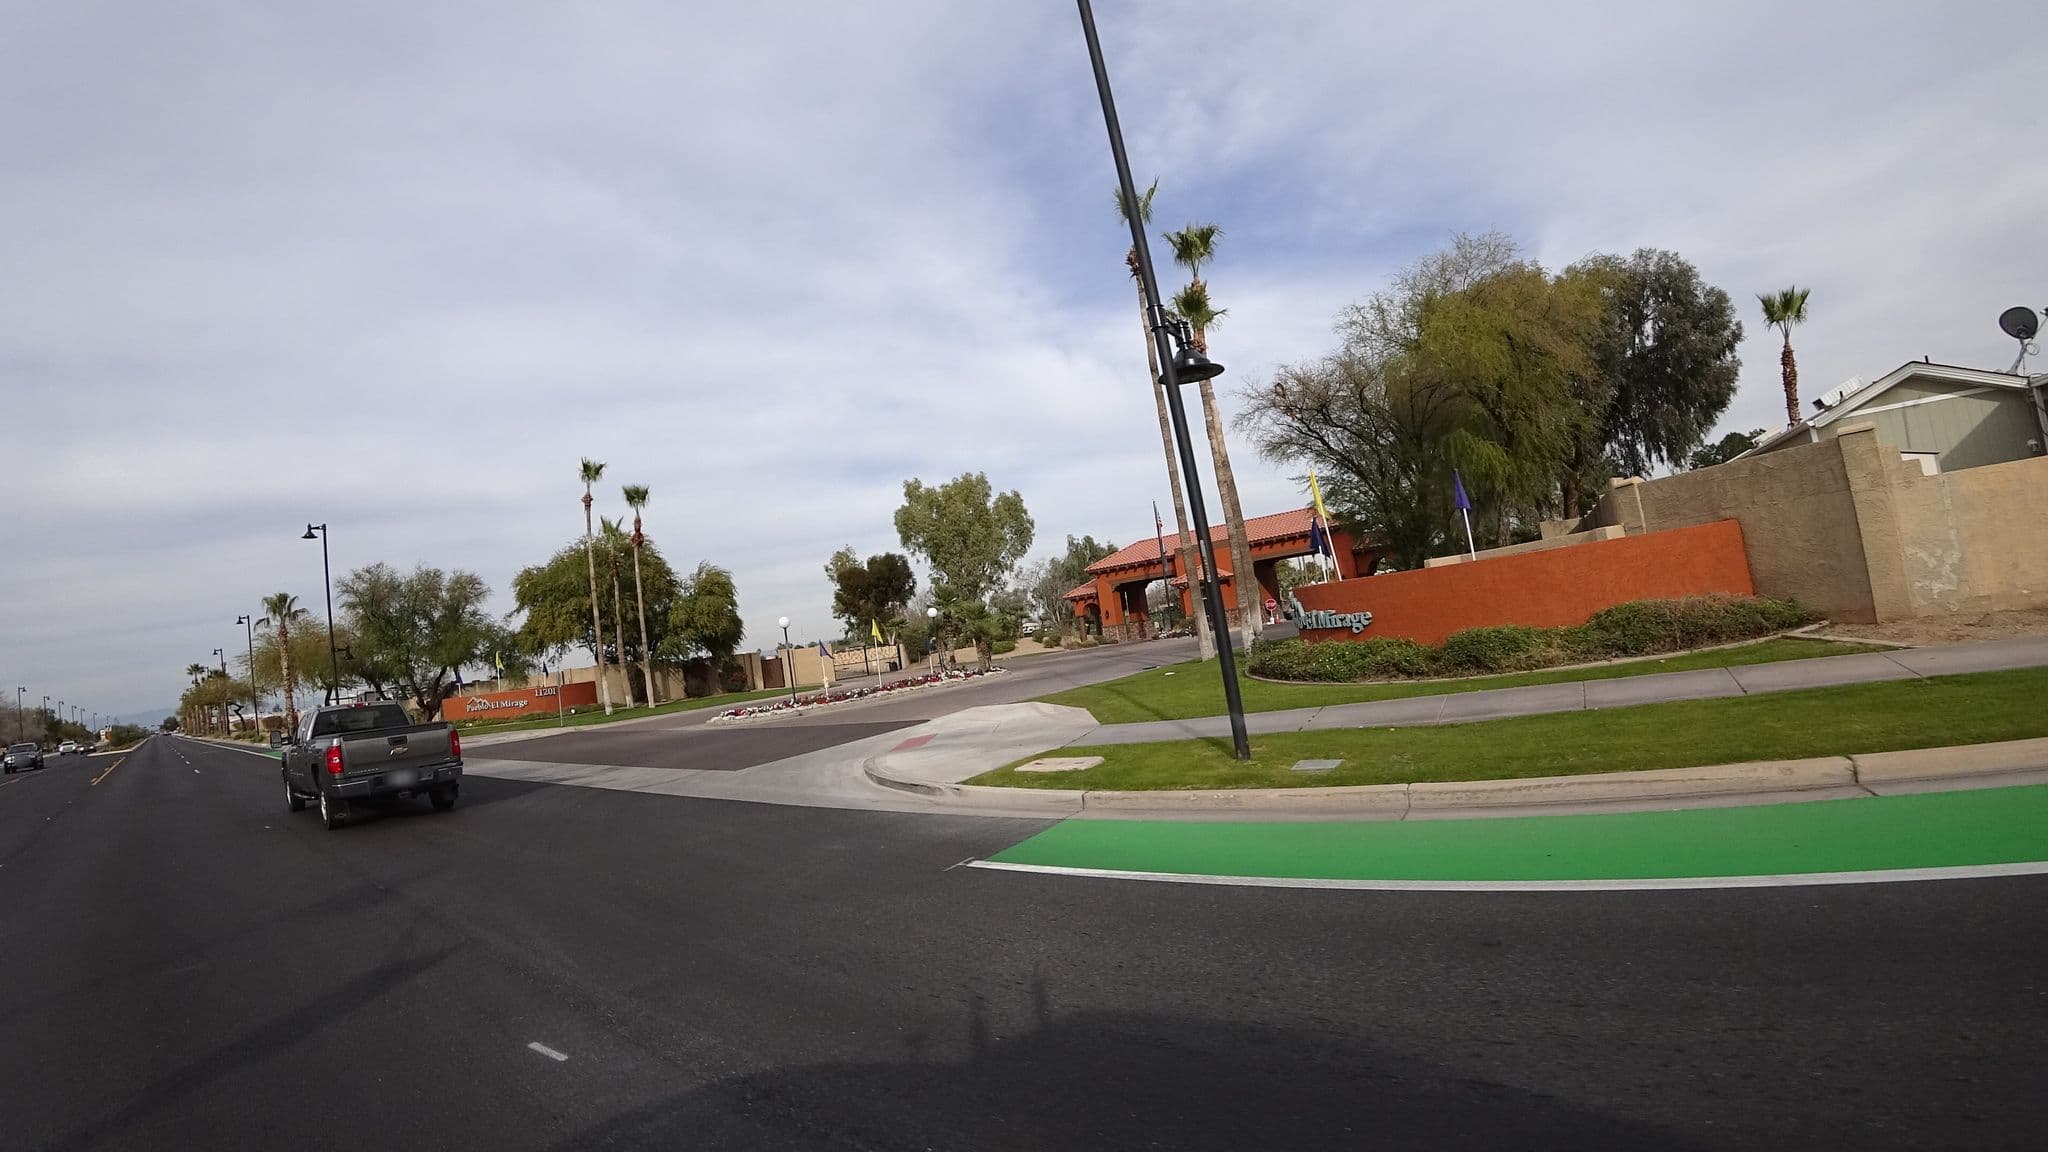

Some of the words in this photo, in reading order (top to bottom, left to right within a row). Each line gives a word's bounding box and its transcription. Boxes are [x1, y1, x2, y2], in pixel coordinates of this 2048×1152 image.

[1318, 609, 1373, 634] Mirage
[535, 687, 556, 696] 11201
[491, 701, 499, 709] El
[500, 699, 528, 708] Mirage
